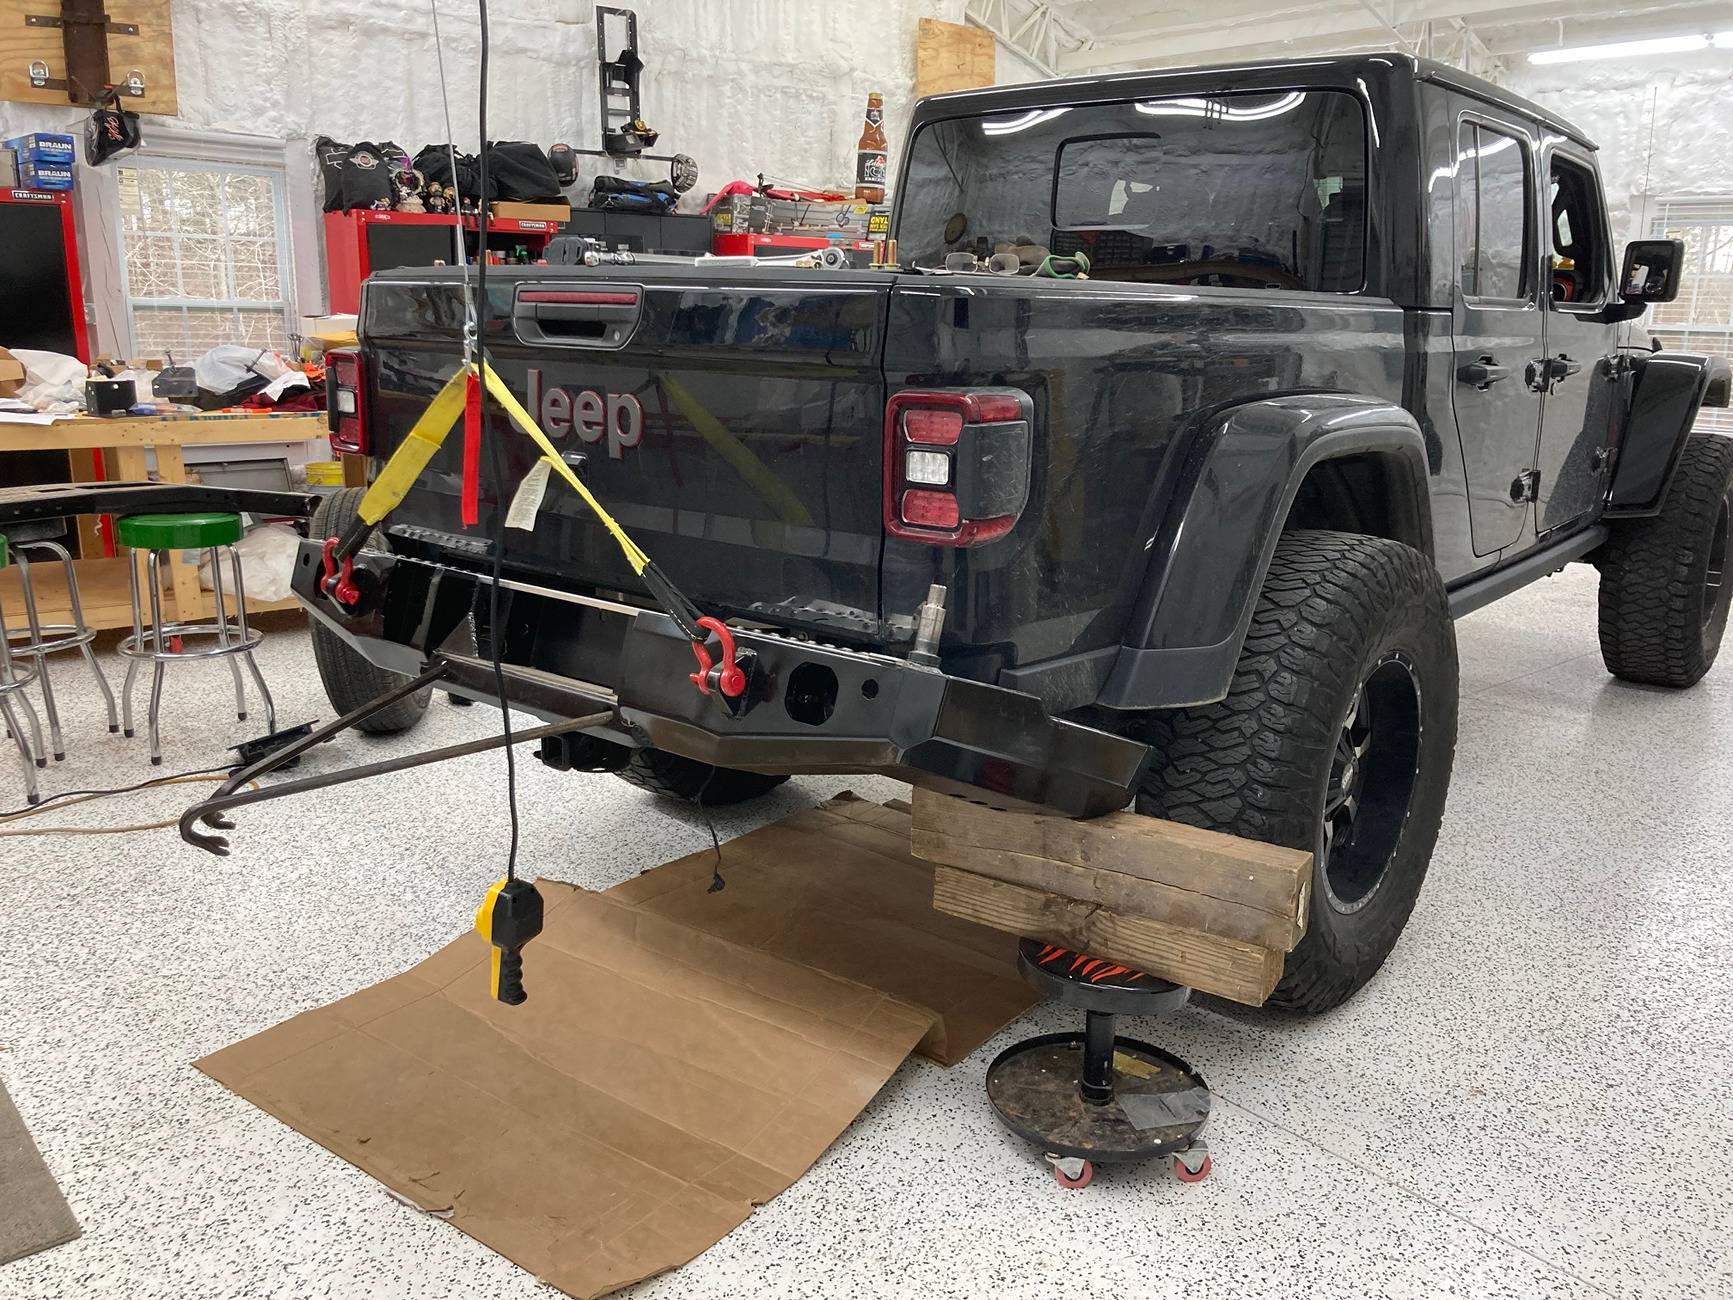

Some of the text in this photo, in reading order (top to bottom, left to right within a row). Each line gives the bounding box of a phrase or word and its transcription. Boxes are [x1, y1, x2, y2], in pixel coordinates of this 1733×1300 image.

[39, 141, 72, 150] BRAUN
[37, 169, 71, 177] BRAUN
[510, 368, 645, 460] Jeep
